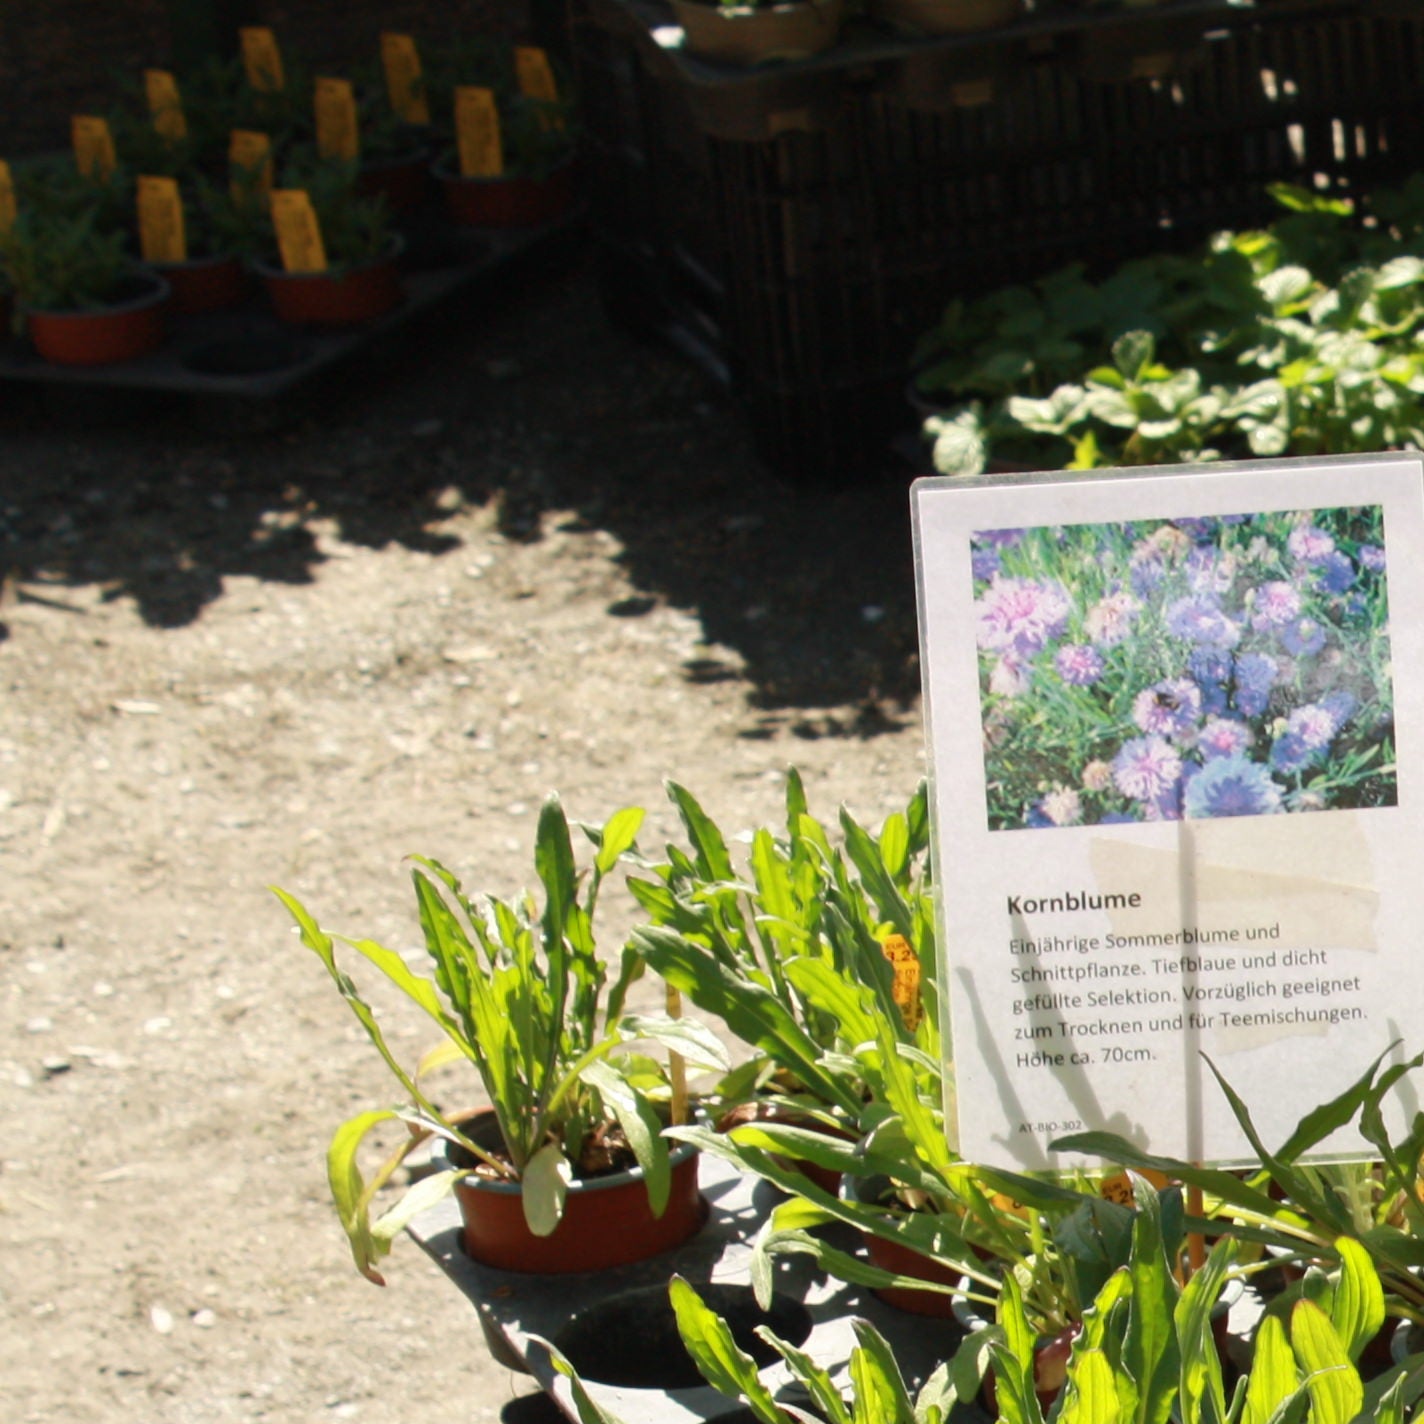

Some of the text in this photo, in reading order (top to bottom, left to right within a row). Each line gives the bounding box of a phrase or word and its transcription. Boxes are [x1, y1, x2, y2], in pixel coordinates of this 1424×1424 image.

[1007, 889, 1142, 915] Kornblume
[1009, 922, 1280, 958] Einjährige Sommerblume und
[1011, 949, 1328, 983] Schnittpflanze. Tiefblaue und dicht
[1012, 978, 1361, 1015] gefüllte Selektion. Vorzüglich geeignet
[1015, 1005, 1368, 1040] zum Trocknen und für Teemischungen.
[1016, 1048, 1157, 1068] Höhe ca. 70cm.
[1019, 1121, 1082, 1134] AT-BIO-302
